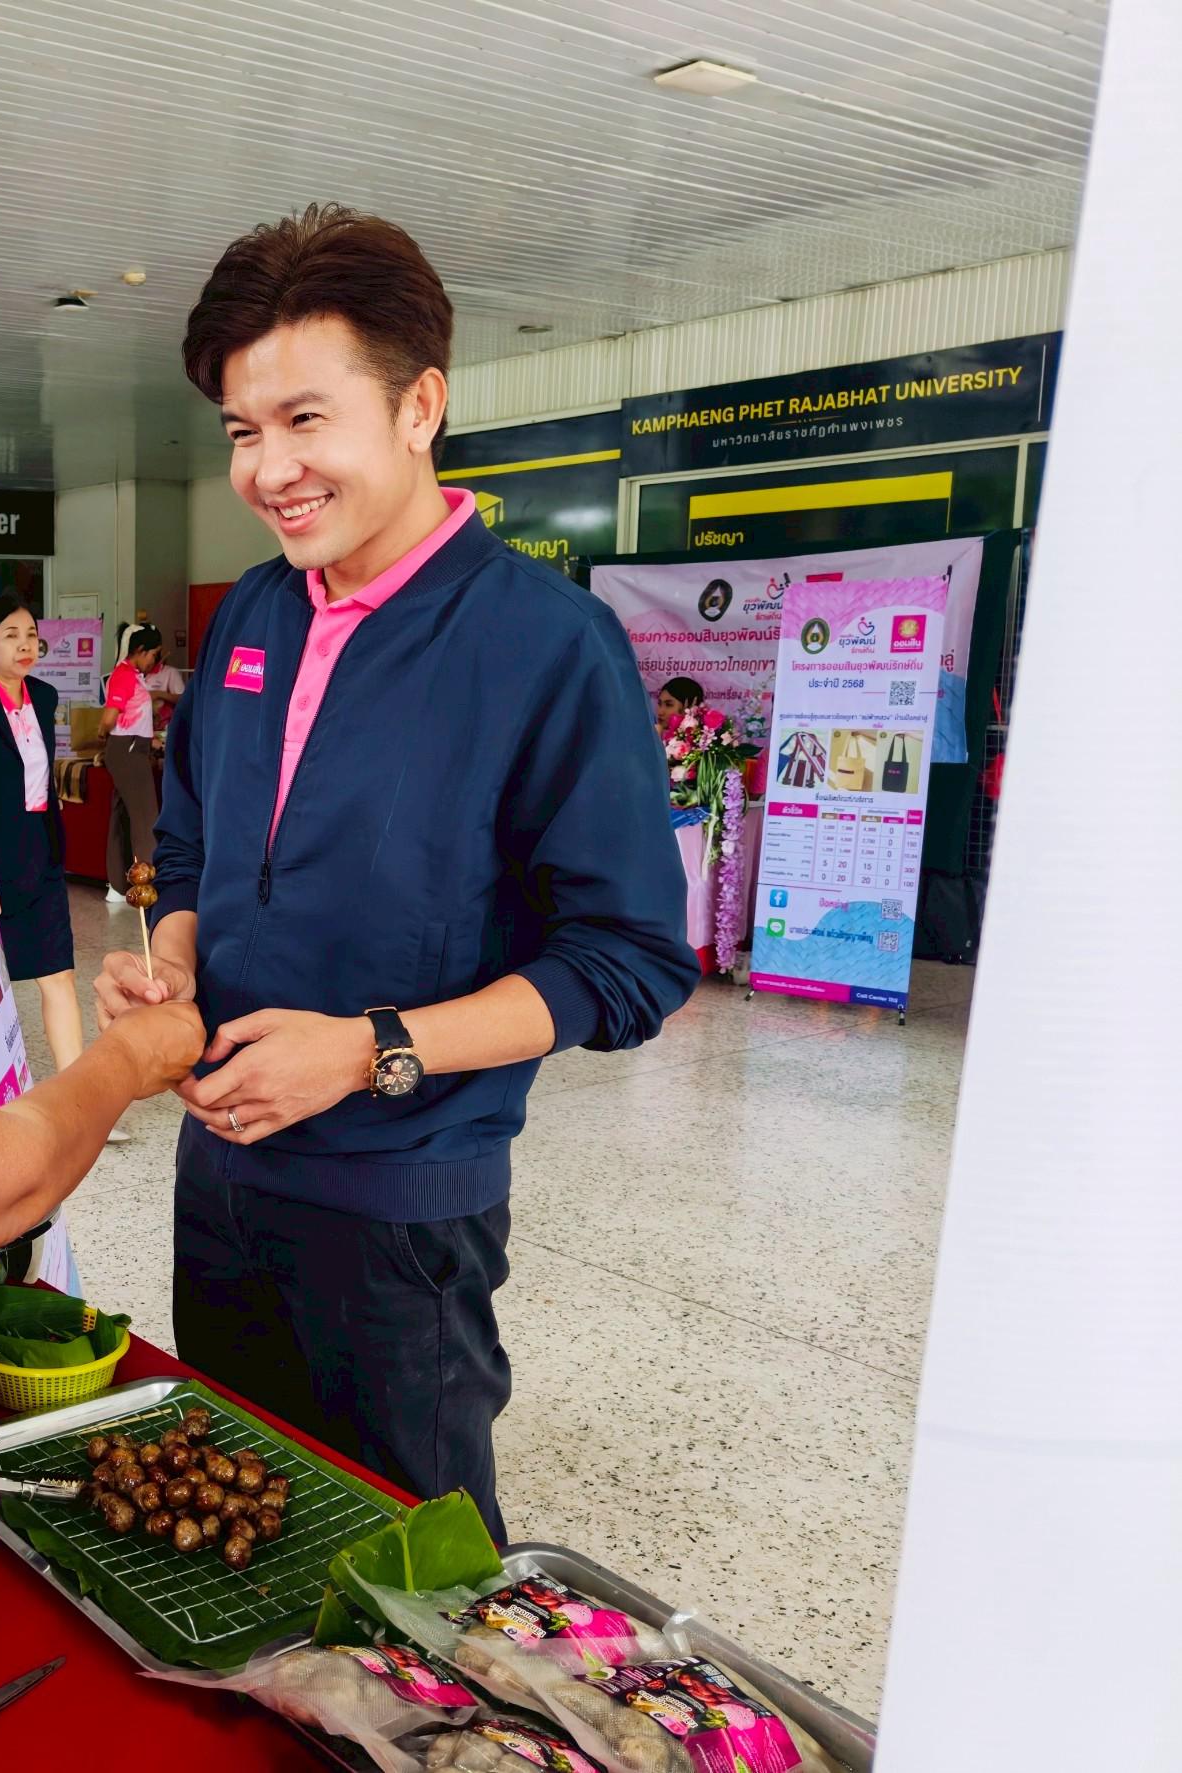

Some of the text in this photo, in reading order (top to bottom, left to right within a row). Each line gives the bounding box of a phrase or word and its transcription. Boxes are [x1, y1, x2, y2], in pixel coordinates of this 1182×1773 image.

[631, 365, 1024, 435] KAMPHAENG PHET RAJABHAT UNIVERSITY
[694, 530, 744, 547] ปรัชญา
[808, 678, 864, 689] ประจำปี 2568
